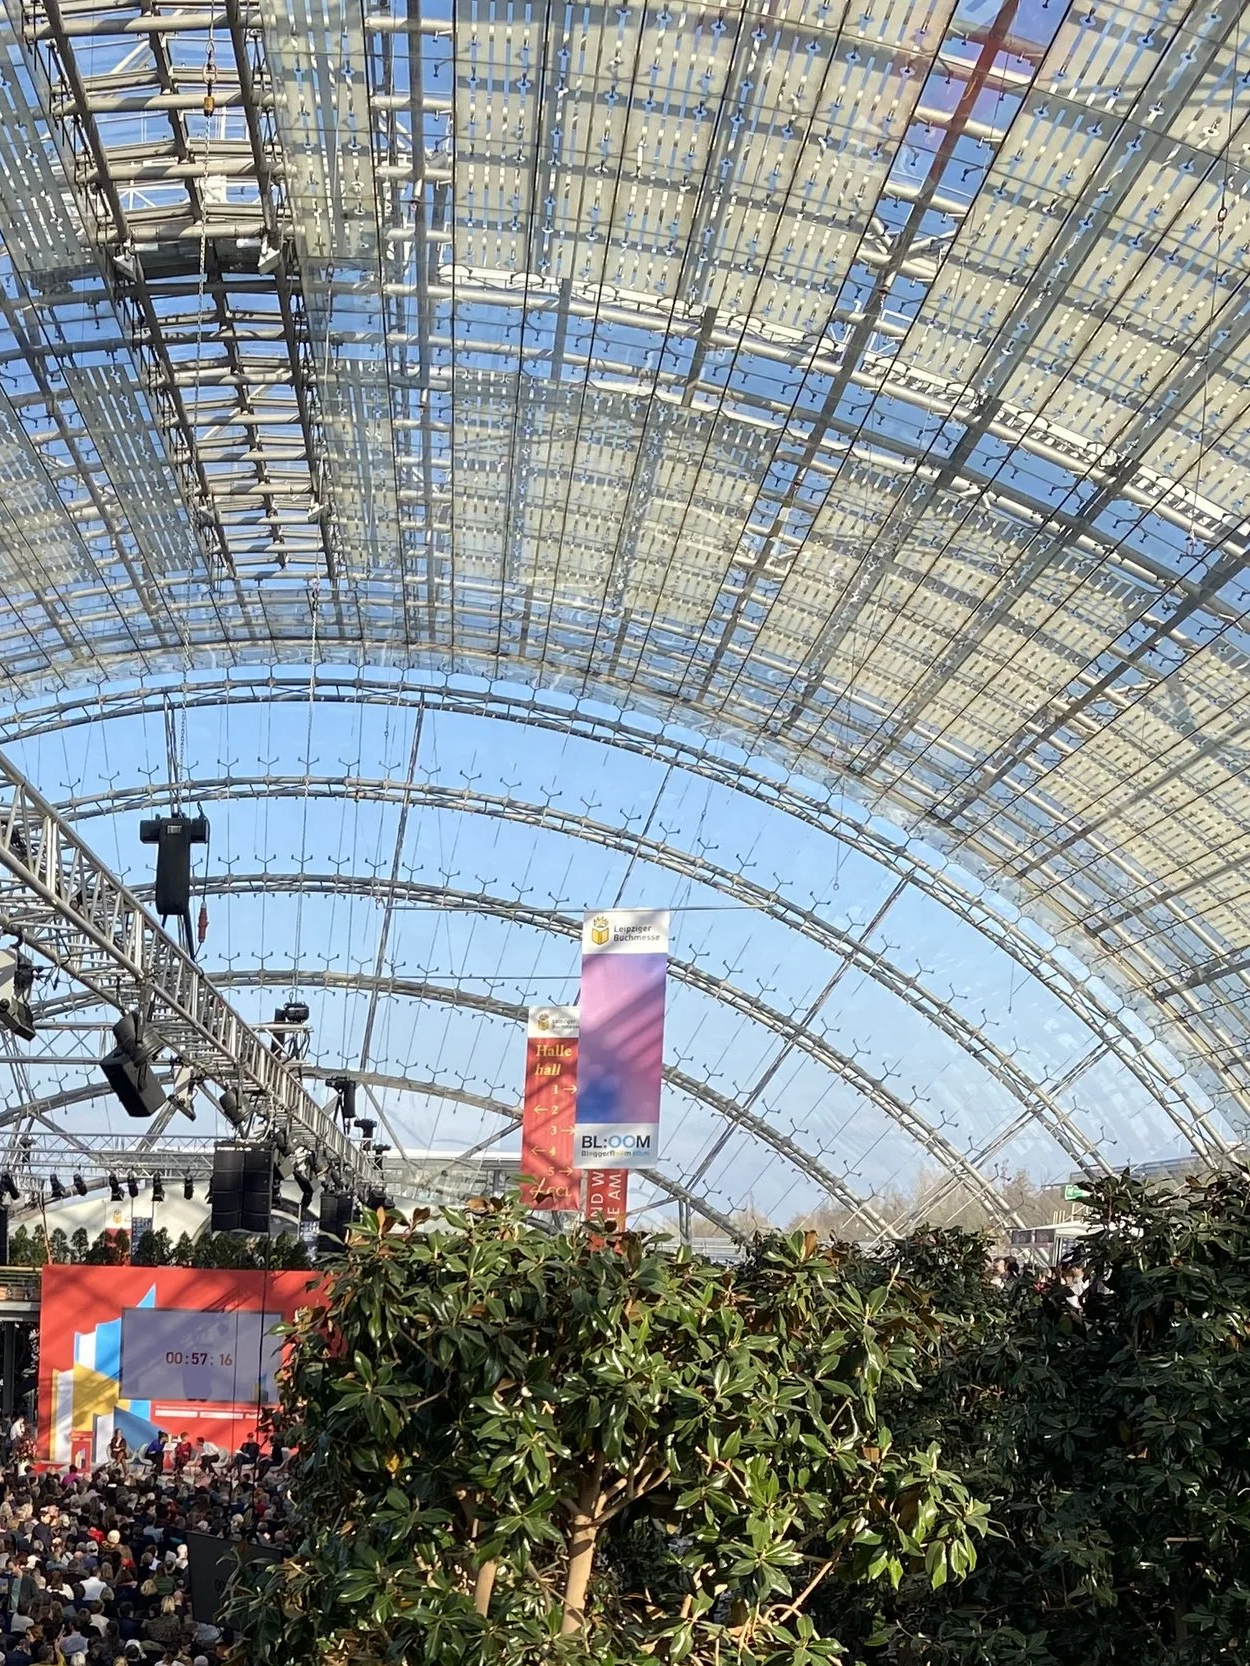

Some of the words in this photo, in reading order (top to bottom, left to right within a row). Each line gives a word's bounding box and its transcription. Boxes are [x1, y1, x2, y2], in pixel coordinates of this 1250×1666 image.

[613, 925, 652, 934] Leipziger
[613, 934, 661, 942] Buchmesse
[536, 1044, 572, 1057] Halle
[534, 1063, 561, 1076] hall
[551, 1105, 559, 1115] 2
[550, 1126, 558, 1136] 3
[582, 1135, 651, 1149] BL:OOM
[549, 1146, 557, 1156] 4
[548, 1166, 555, 1176] 5
